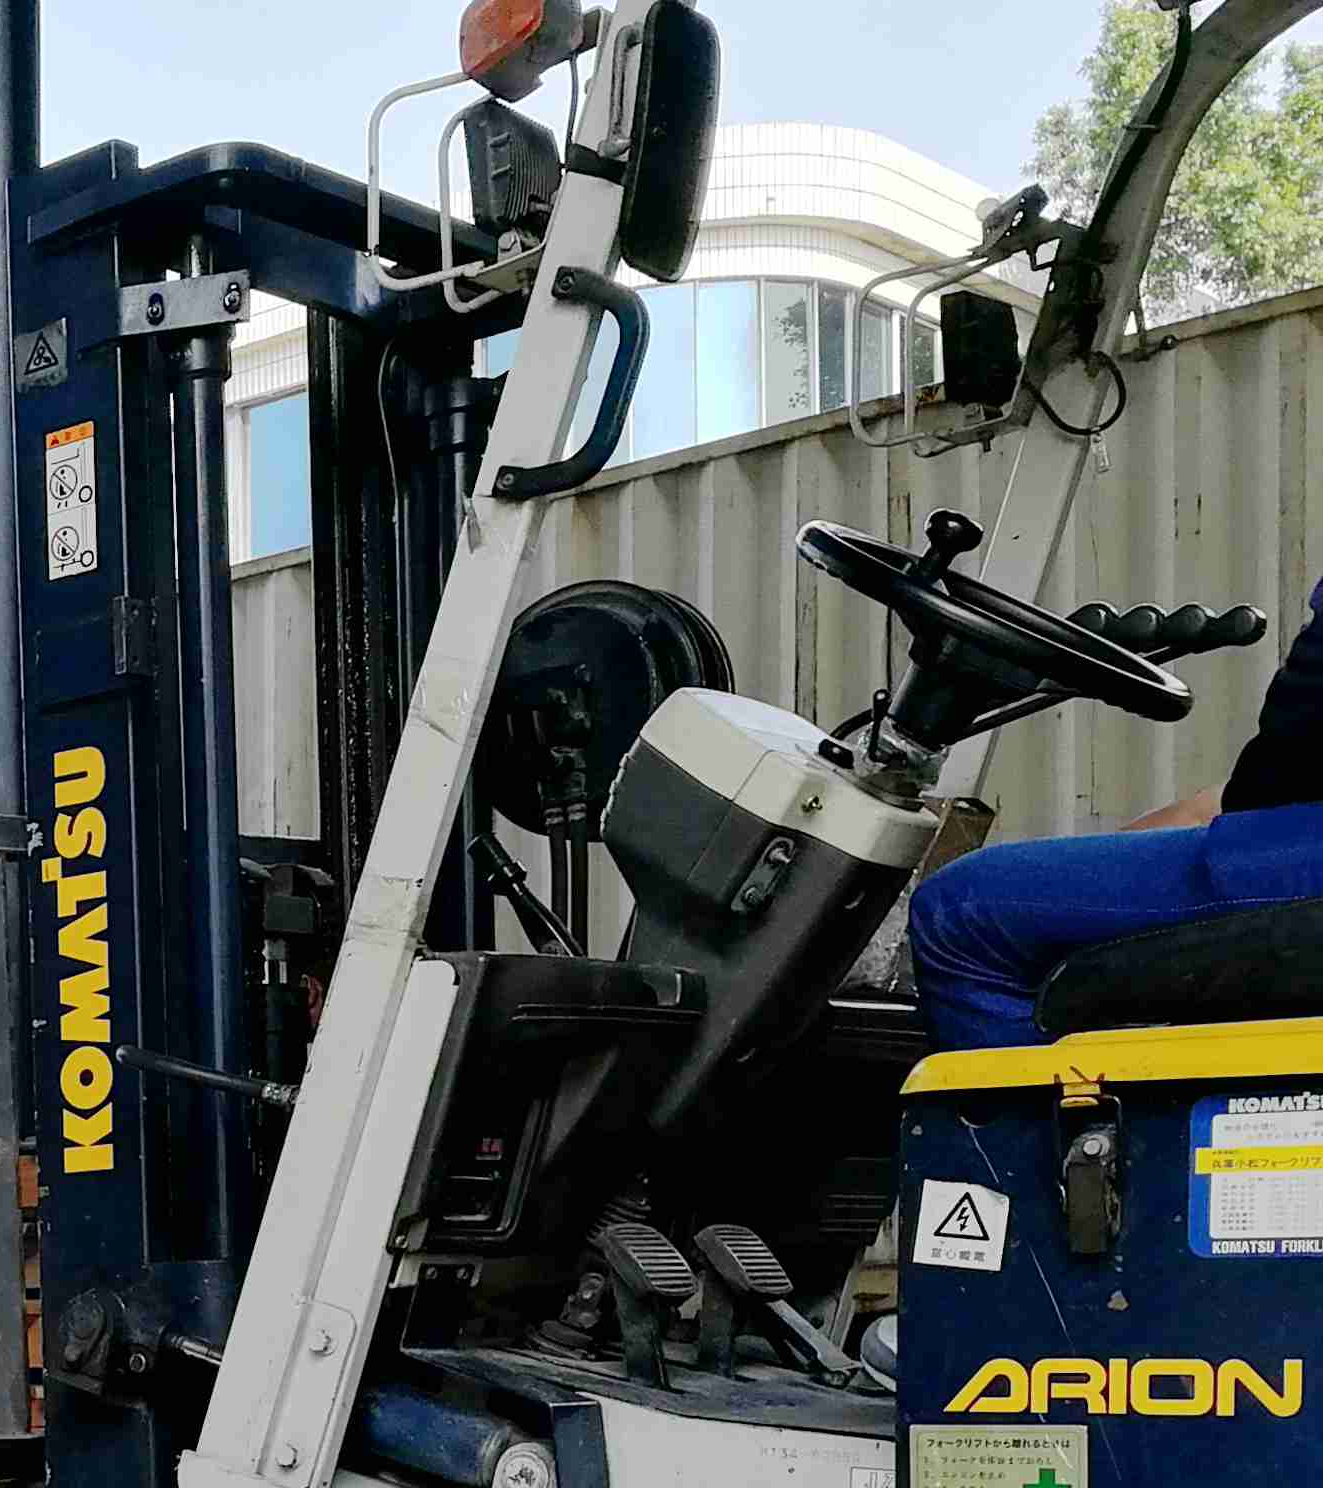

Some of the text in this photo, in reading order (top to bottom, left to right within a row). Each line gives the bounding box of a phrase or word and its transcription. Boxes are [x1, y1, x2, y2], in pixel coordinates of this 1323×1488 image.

[42, 745, 115, 1174] KOMATSU
[1228, 1092, 1323, 1114] KOMATS
[1212, 1239, 1323, 1254] KOMATSU FORKL
[943, 1358, 1303, 1418] ARION
